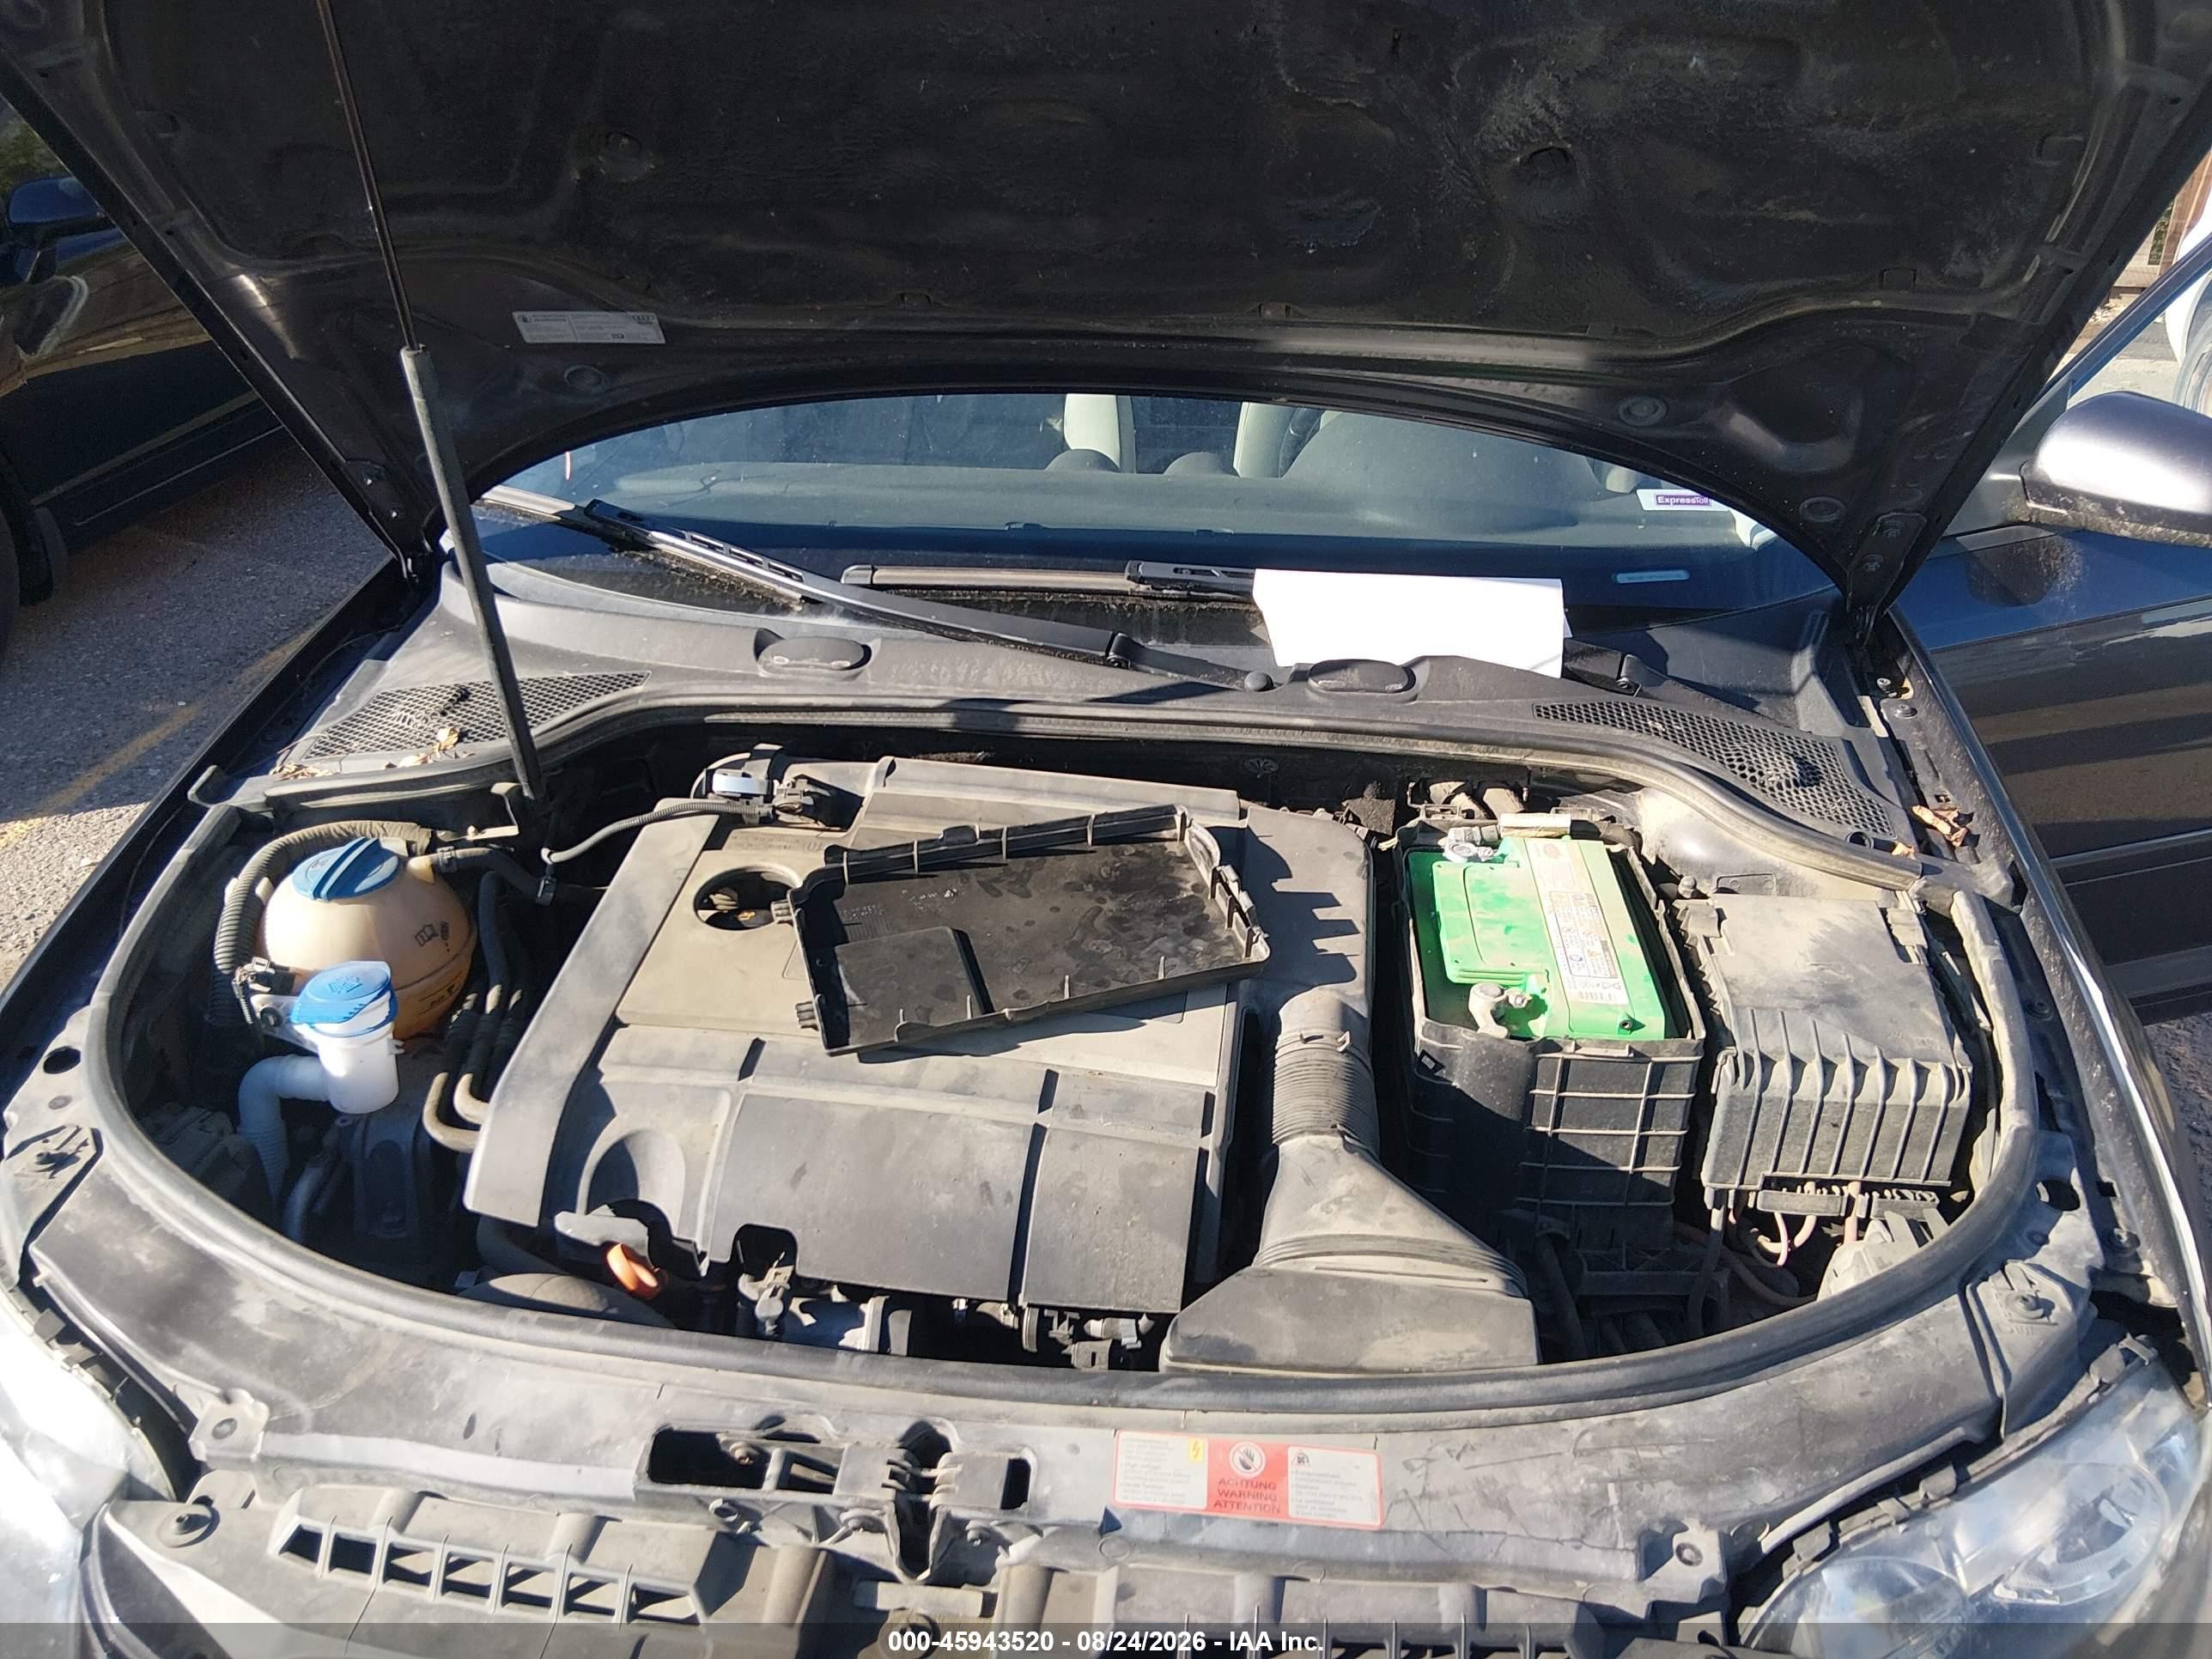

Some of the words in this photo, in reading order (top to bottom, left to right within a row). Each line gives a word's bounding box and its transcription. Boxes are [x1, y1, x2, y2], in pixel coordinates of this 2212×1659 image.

[1218, 1478, 1277, 1490] ACHTUNG
[1218, 1488, 1277, 1502] WARNING
[1214, 1499, 1280, 1514] ATTENTION
